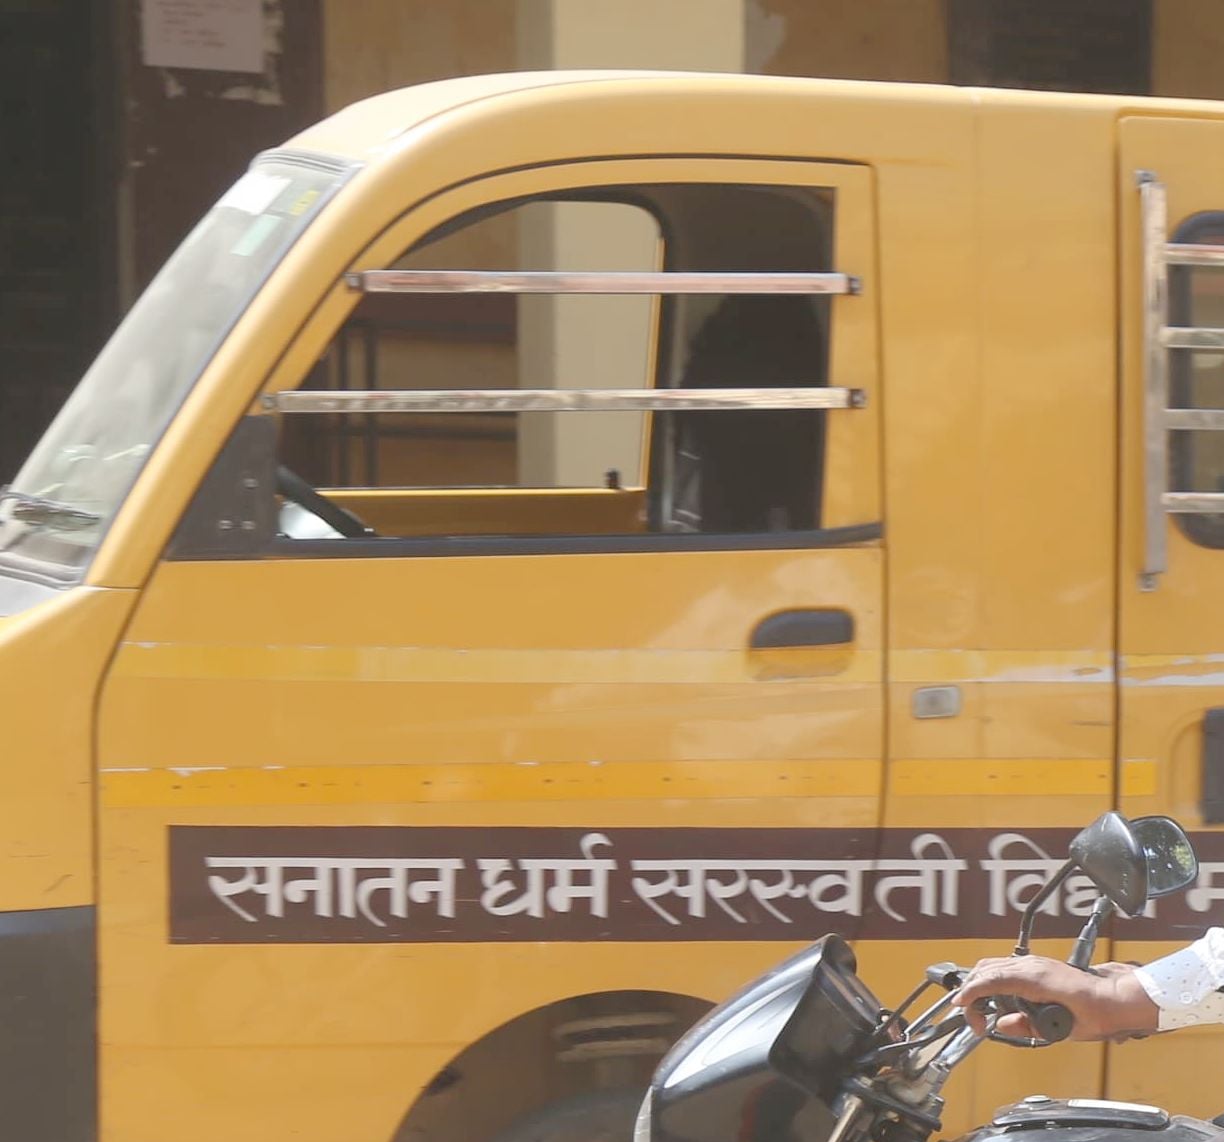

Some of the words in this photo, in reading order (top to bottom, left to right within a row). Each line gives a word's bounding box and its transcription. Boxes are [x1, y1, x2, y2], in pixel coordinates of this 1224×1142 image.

[205, 856, 463, 926] सनातन
[477, 833, 617, 918] धर्म
[631, 833, 967, 924] सरस्वती
